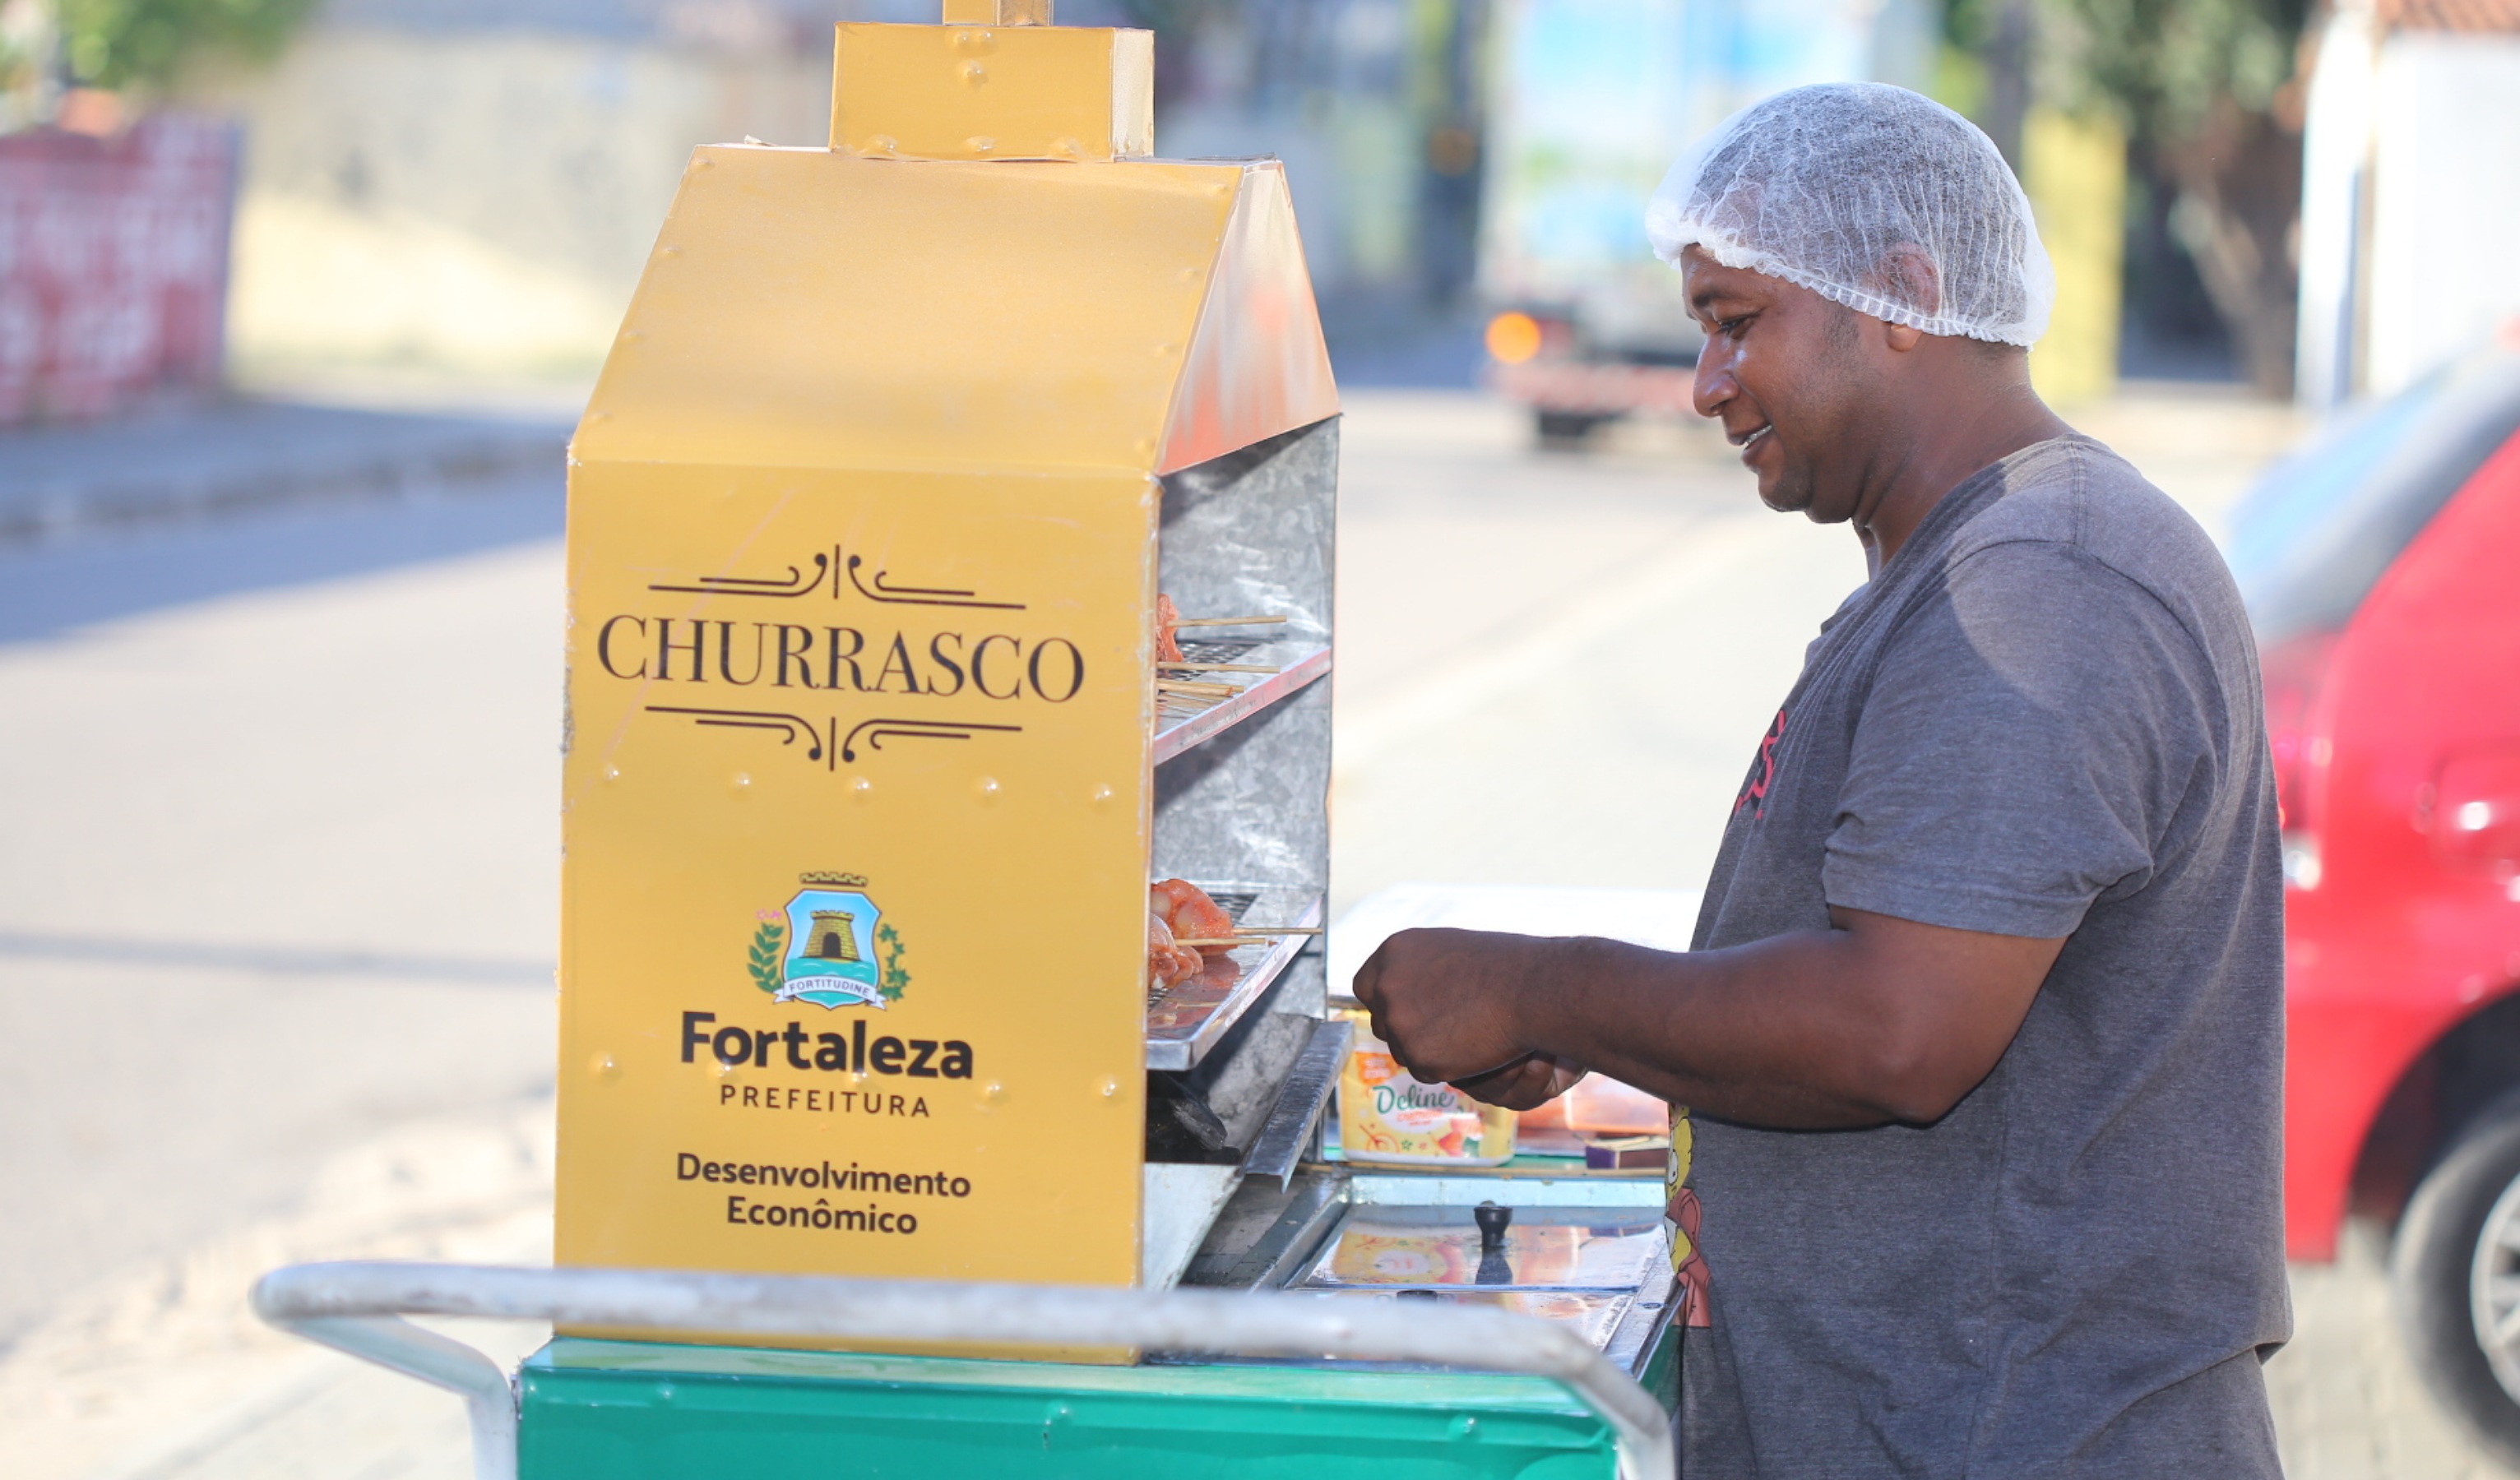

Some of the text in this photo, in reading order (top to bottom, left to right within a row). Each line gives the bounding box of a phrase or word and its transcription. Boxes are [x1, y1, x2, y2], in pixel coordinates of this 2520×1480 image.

[598, 614, 1084, 703] CHURRASCO
[788, 978, 871, 997] FORTITUDINE
[682, 1011, 973, 1080] Fortaleza
[720, 1085, 930, 1117] PREFEITURA
[1372, 1084, 1455, 1114] Deline
[677, 1153, 971, 1198] Desenvolvimento
[727, 1196, 918, 1235] Econômico
